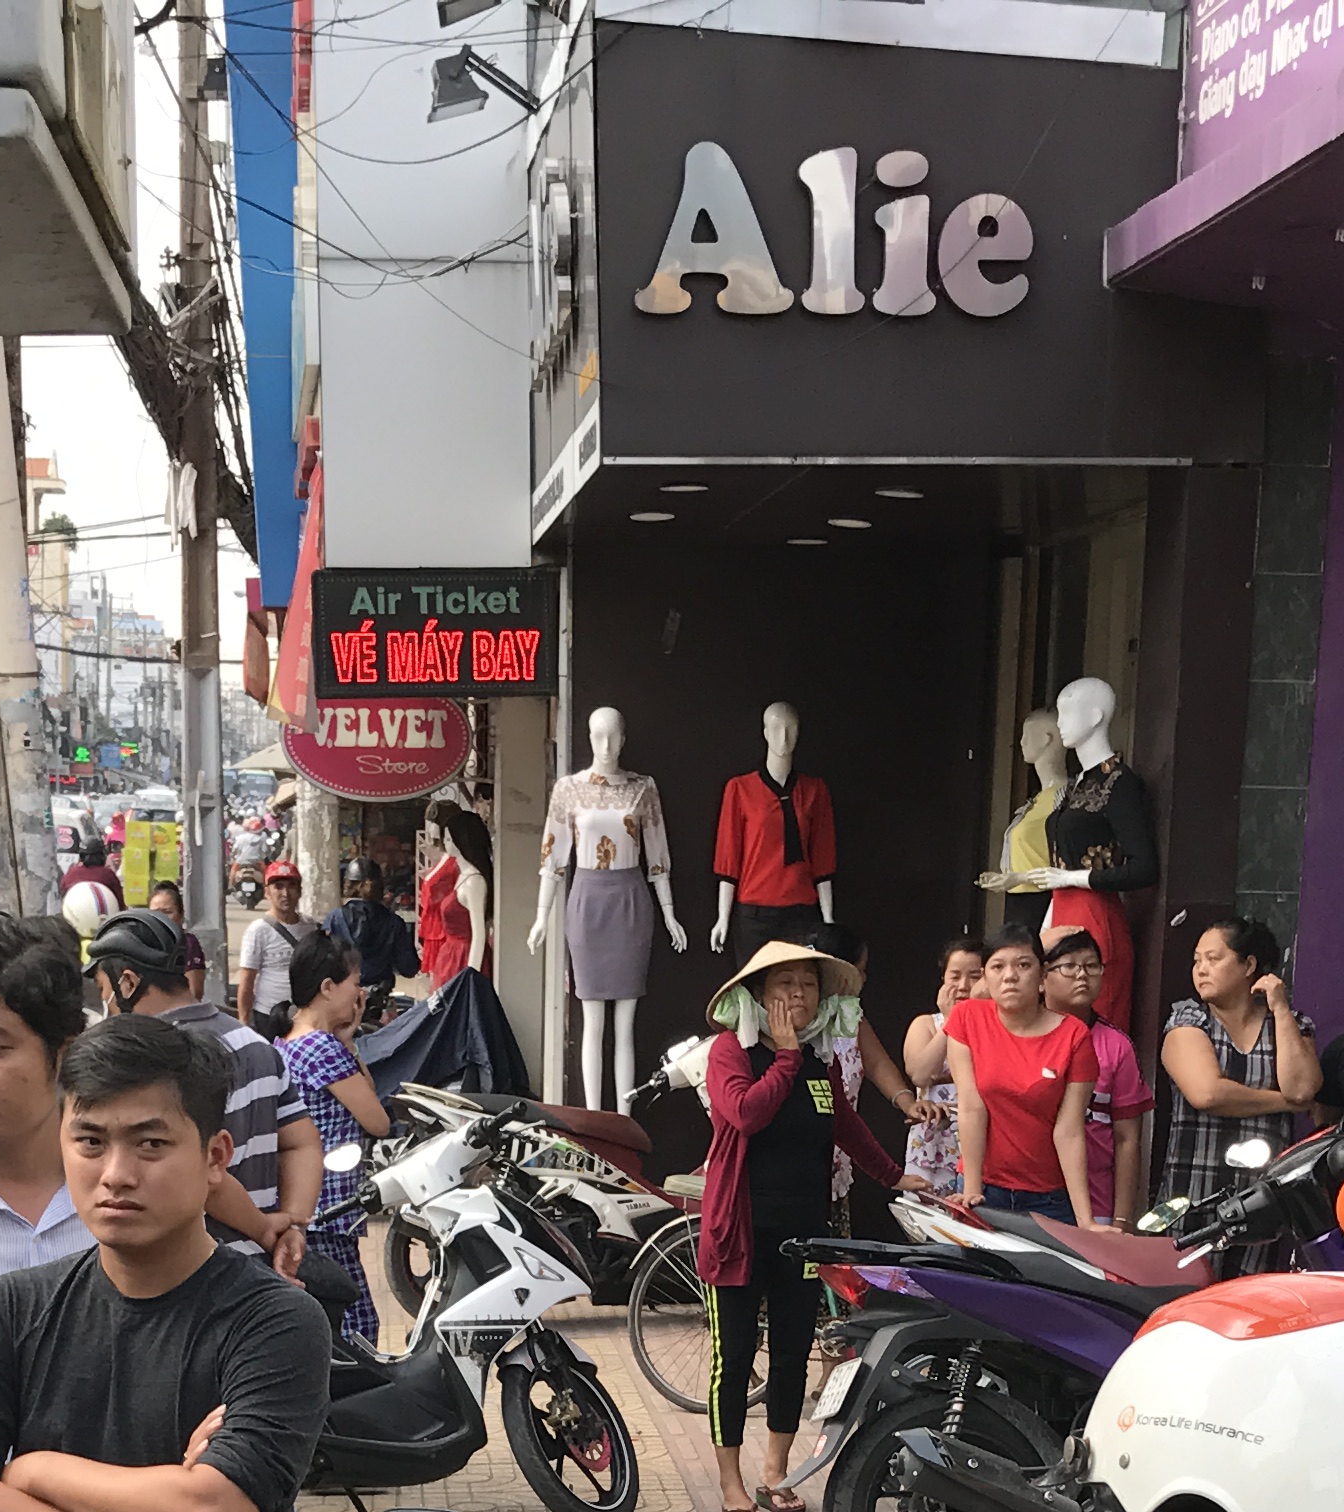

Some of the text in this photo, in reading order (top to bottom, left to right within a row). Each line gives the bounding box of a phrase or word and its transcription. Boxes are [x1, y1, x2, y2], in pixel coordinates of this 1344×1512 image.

[1198, 67, 1235, 124] Giảng
[1238, 49, 1267, 101] dạy
[1271, 15, 1310, 76] Nhạc
[1200, 13, 1238, 72] Piano
[633, 140, 1035, 317] Alie
[349, 585, 521, 615] Air Ticket
[330, 618, 541, 683] VÉ MÁY BAY
[355, 754, 430, 775] Store
[1135, 1413, 1168, 1427] Korea
[1169, 1415, 1193, 1430] Life
